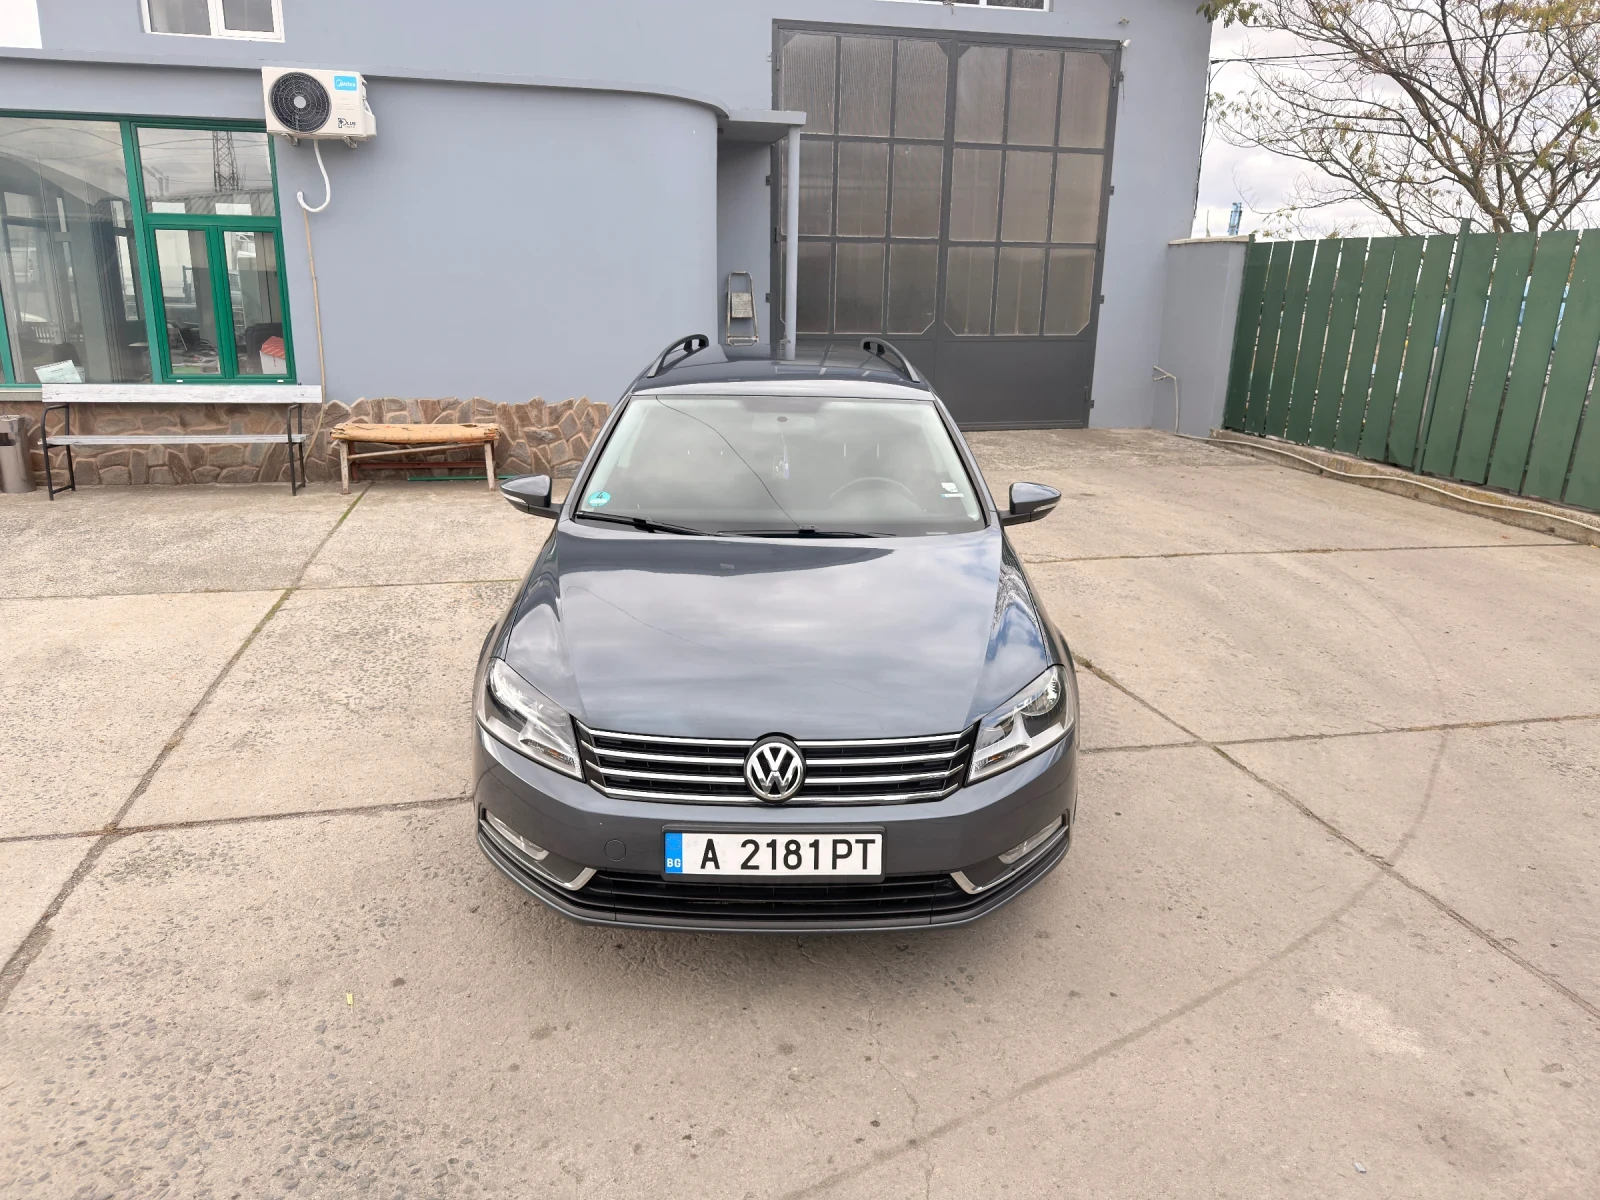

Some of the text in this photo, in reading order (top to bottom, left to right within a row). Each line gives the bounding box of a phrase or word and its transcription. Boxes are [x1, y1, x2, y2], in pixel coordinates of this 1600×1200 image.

[747, 742, 803, 798] VW
[666, 858, 681, 867] BG
[700, 838, 876, 870] A 2181PT
